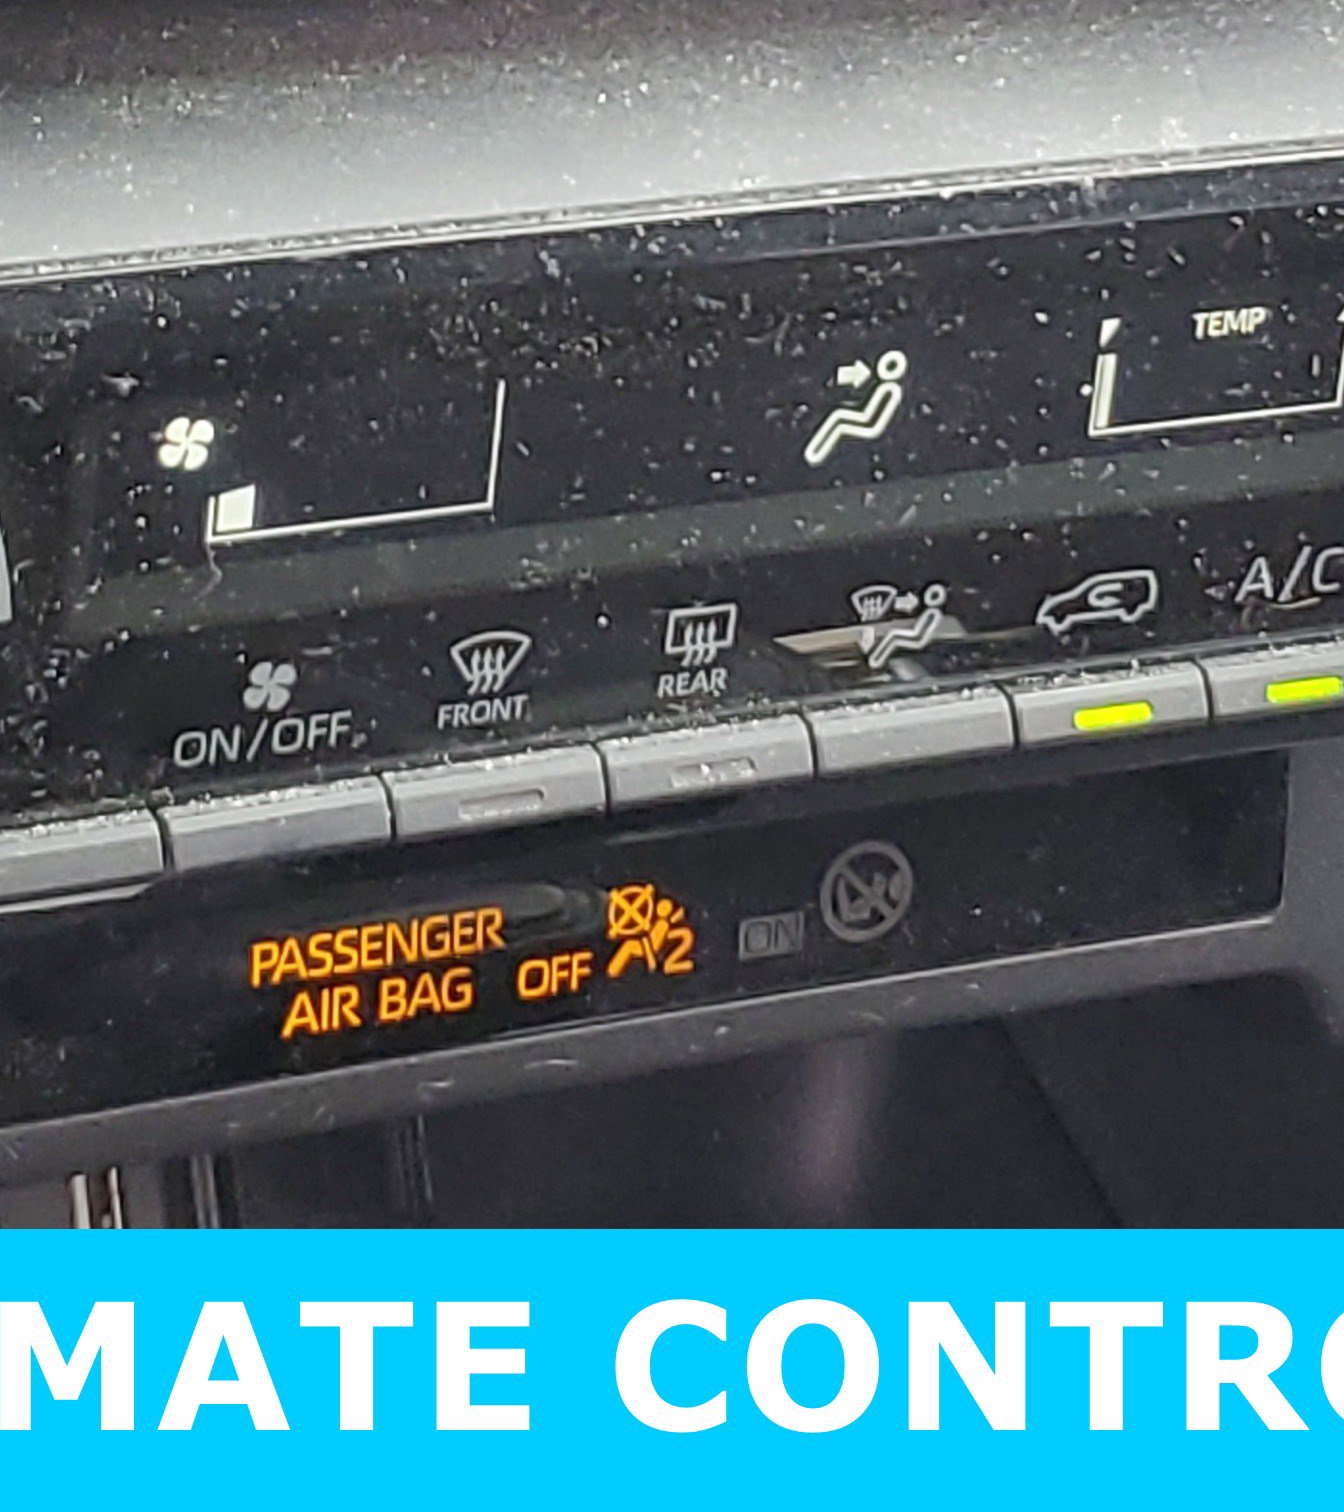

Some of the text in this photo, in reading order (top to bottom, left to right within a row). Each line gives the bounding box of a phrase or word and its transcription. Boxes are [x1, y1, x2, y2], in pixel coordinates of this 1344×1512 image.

[1192, 306, 1267, 341] TEMP
[657, 666, 728, 699] REAR
[437, 694, 529, 730] FRONT
[172, 711, 353, 769] ON/OFF
[250, 906, 506, 988] PASSENGER
[744, 915, 801, 956] ON
[280, 987, 363, 1040] AIR
[377, 966, 474, 1023] BAG
[516, 951, 593, 1001] OFF
